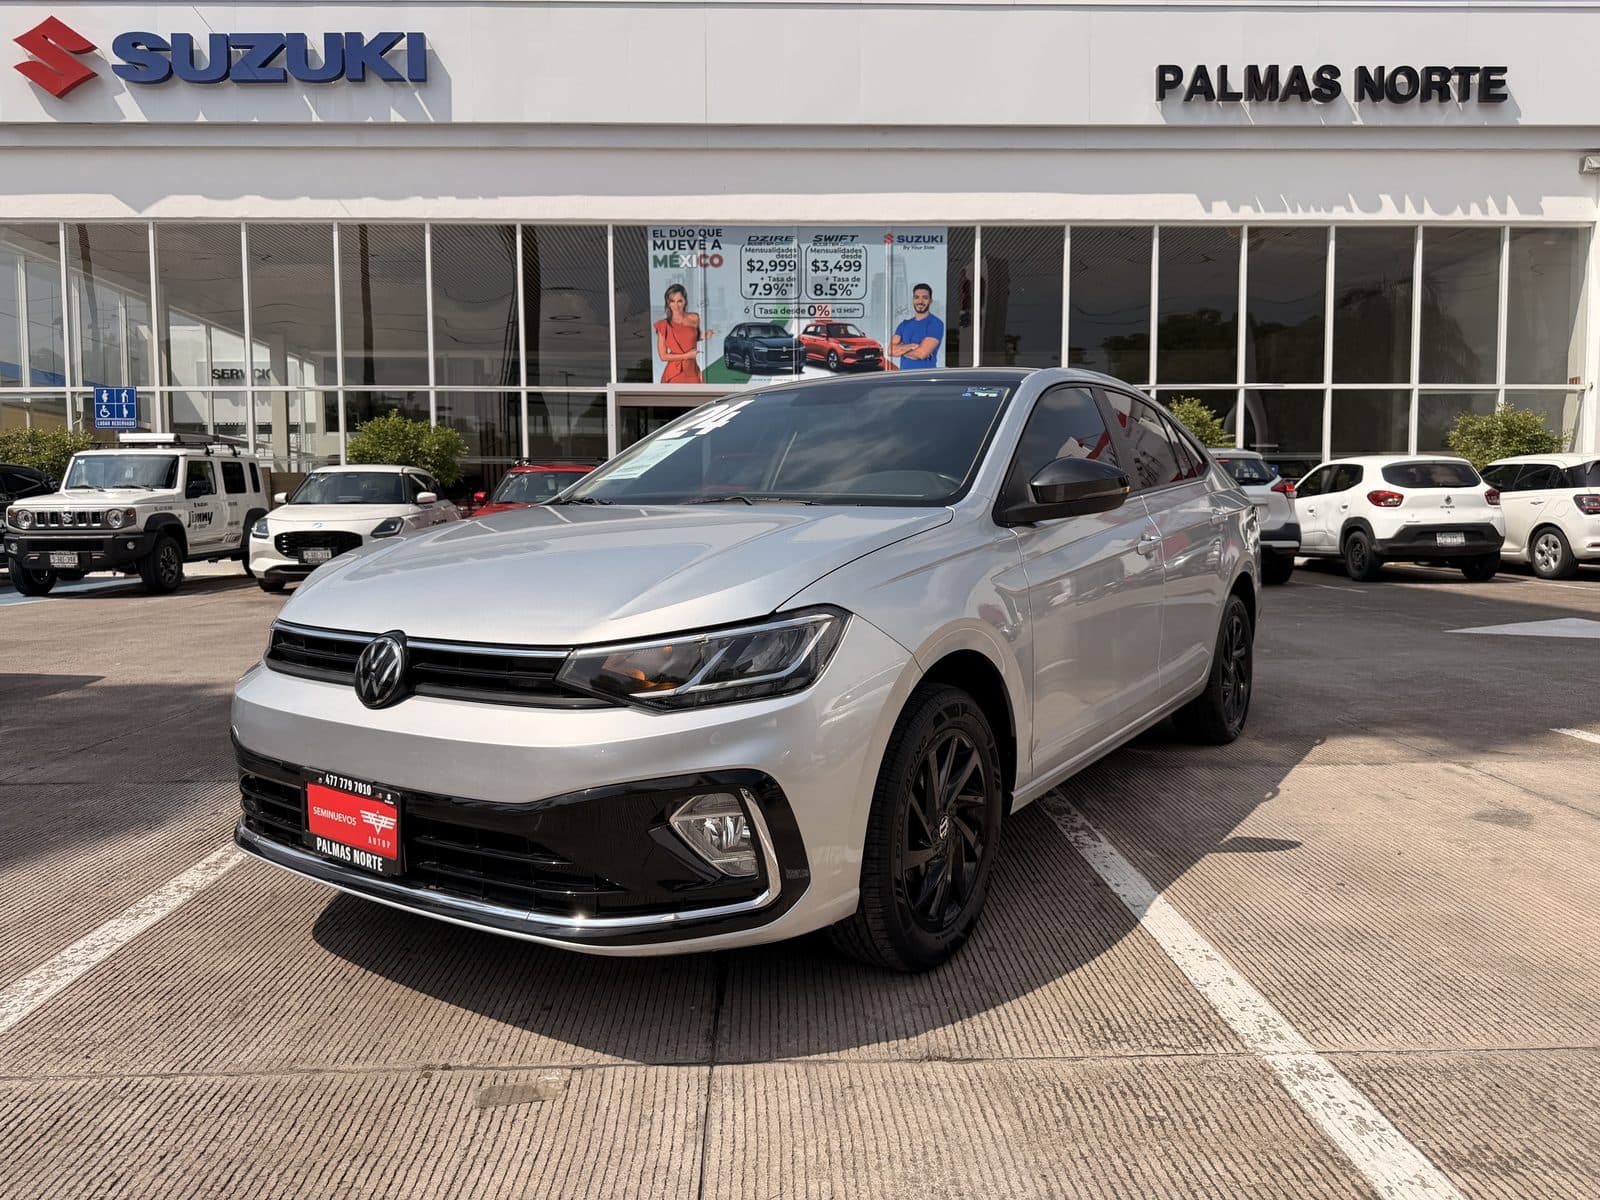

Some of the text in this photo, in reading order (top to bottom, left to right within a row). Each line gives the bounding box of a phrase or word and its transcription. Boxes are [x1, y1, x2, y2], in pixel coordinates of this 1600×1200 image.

[111, 31, 427, 84] SUZUKI
[1155, 64, 1508, 104] PALMAS NORTE
[652, 227, 722, 239] EL DÚO QUE
[812, 234, 859, 242] SWIFT
[896, 234, 943, 243] SUZUKI
[652, 239, 722, 251] MUEVE A
[652, 251, 724, 268] MÉXICO
[746, 258, 797, 274] $2,999
[811, 258, 862, 274] $3,499
[758, 307, 778, 315] Tasa
[780, 307, 806, 315] desde
[807, 304, 830, 317] 0%
[212, 368, 272, 380] SERVCI
[325, 773, 372, 796] 477 779 7010
[312, 805, 357, 826] SEMINUEVOS
[316, 836, 383, 872] PALMAS NORTE
